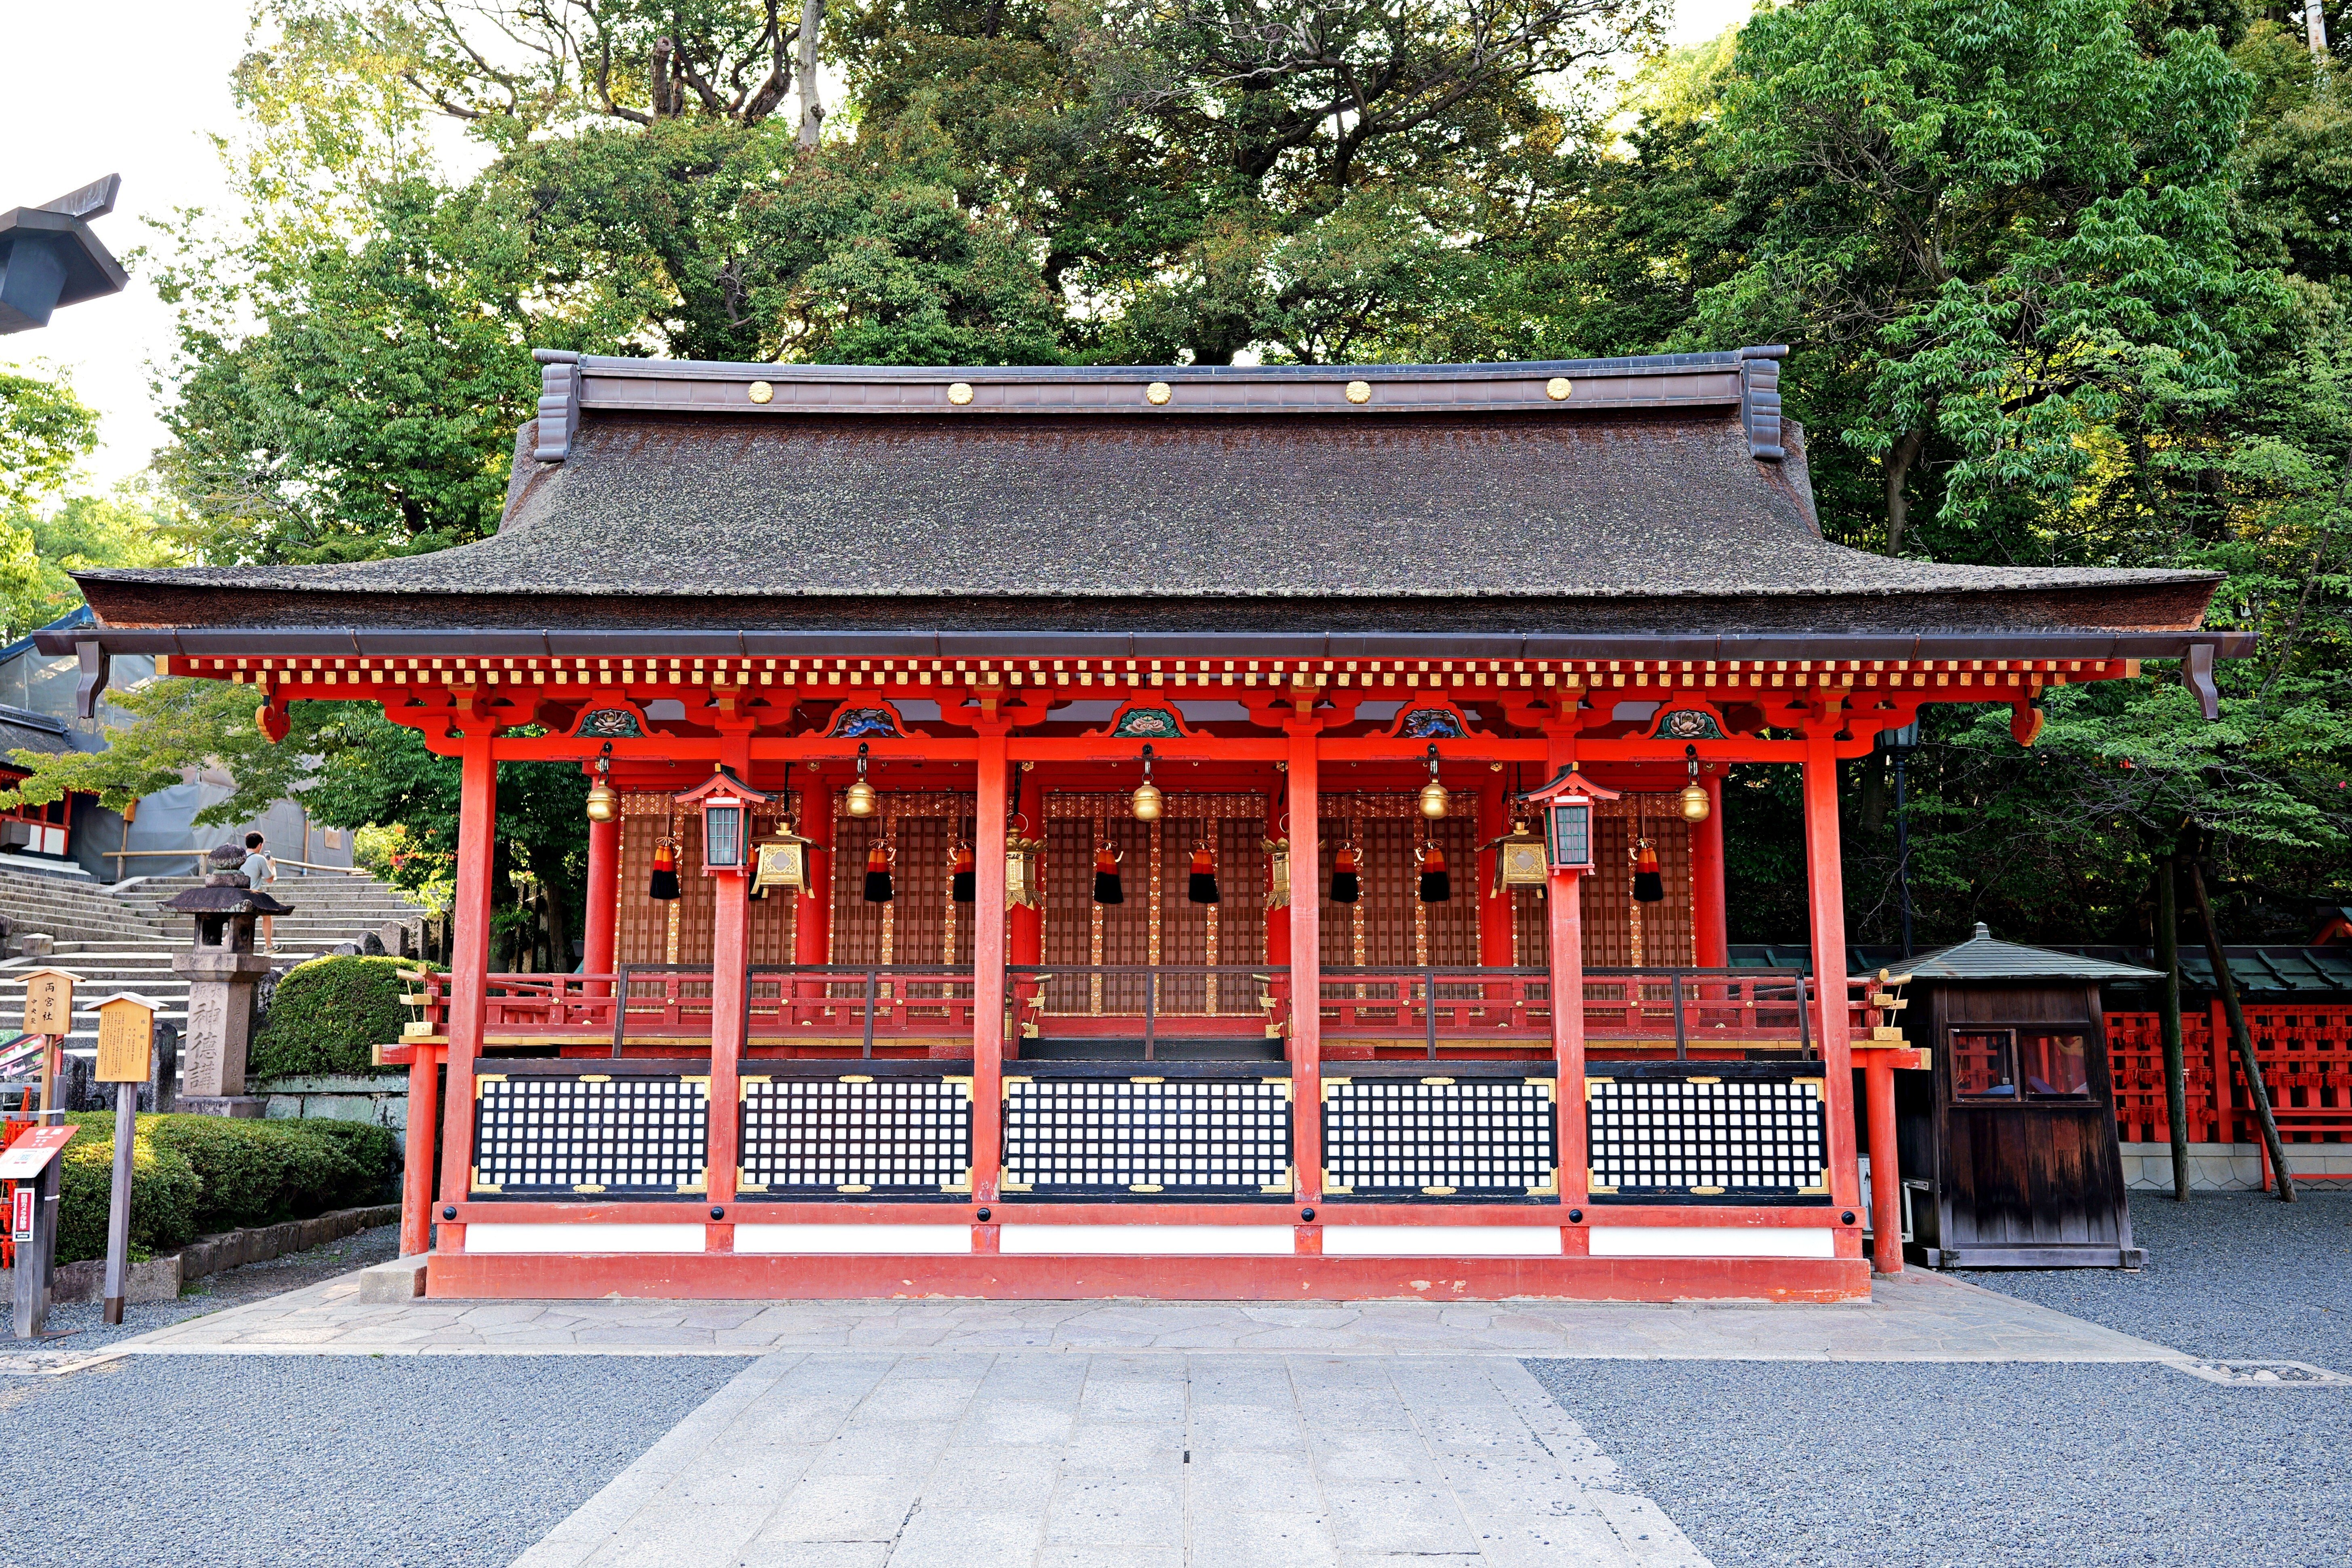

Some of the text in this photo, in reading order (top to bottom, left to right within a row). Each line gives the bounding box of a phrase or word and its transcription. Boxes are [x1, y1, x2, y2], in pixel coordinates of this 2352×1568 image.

[42, 982, 54, 1021] 両宮社
[19, 1193, 28, 1230] 防犯カメラ作動中
